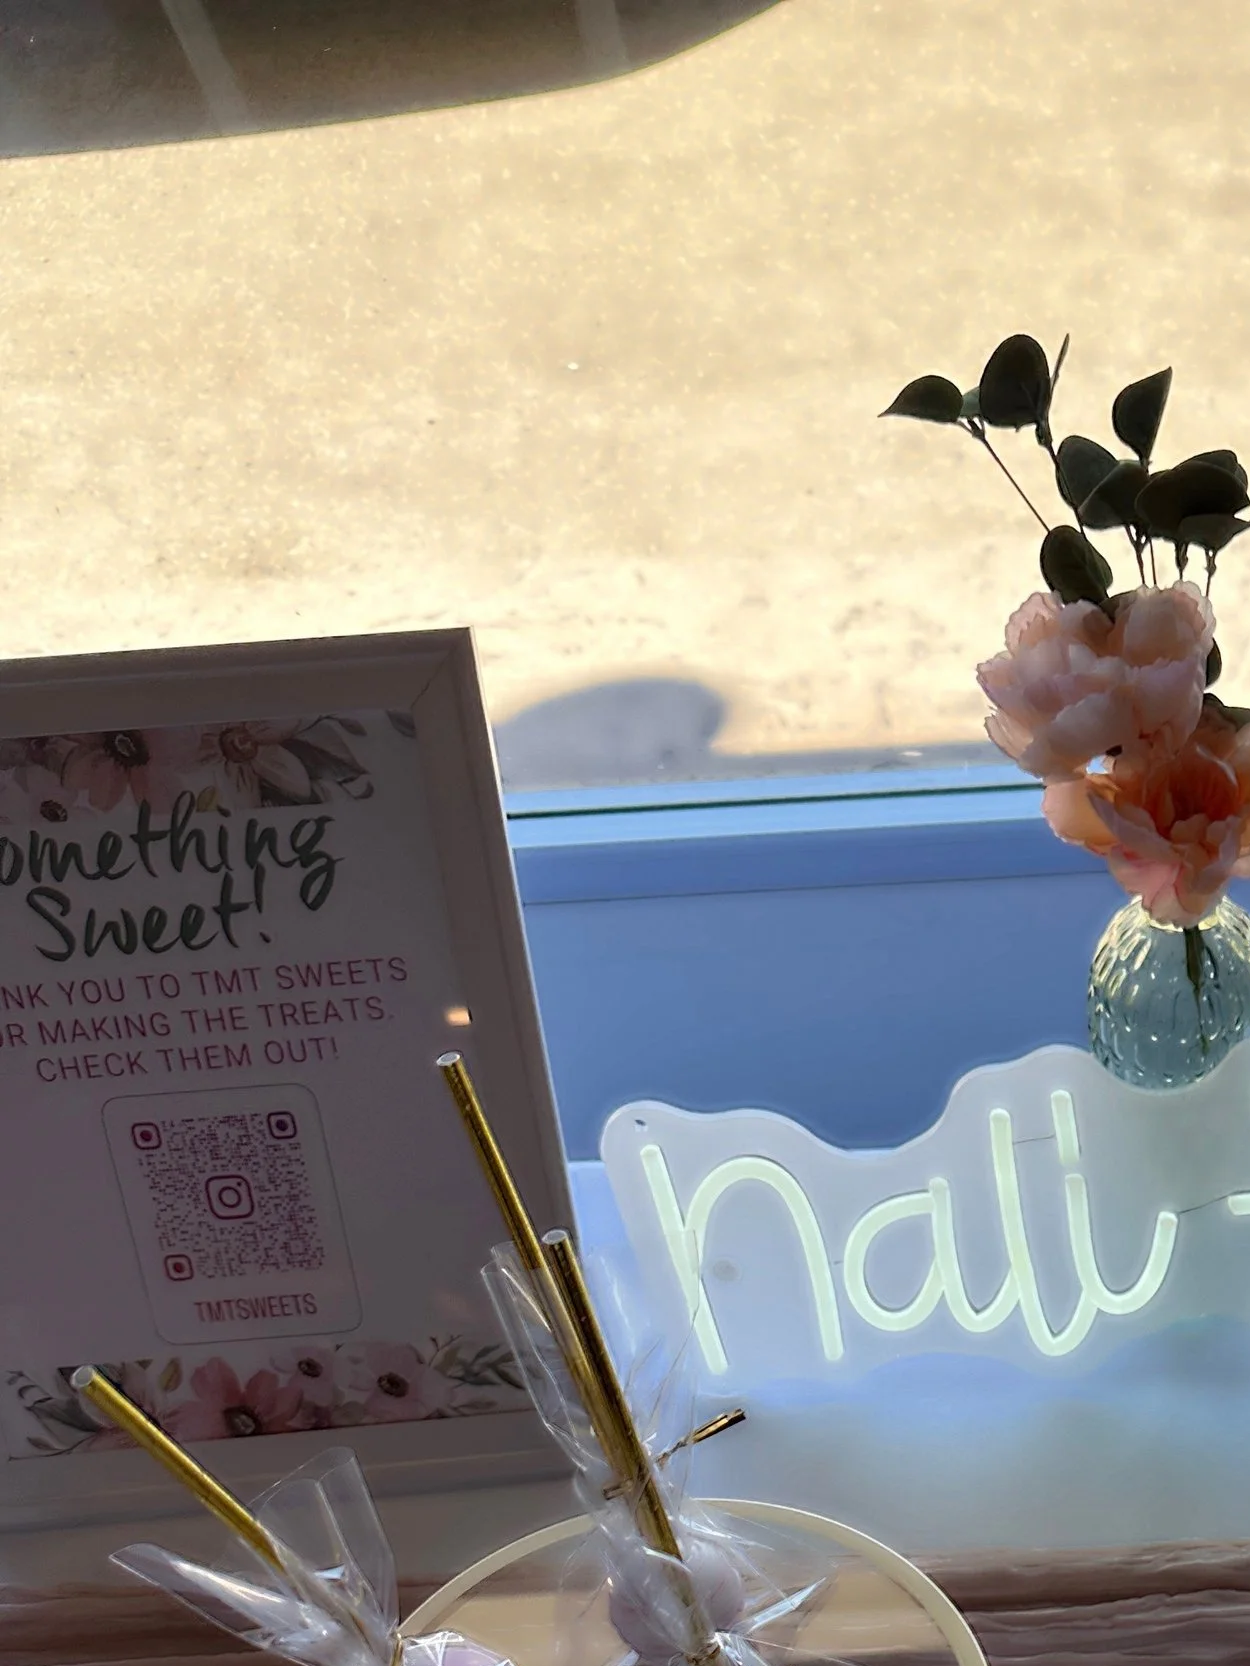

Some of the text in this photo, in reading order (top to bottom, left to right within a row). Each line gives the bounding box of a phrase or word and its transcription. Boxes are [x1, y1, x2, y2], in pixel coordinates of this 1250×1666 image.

[0, 790, 345, 911] omething
[26, 864, 272, 962] Sweet!
[0, 956, 408, 1010] NK YOU TO TMT SWEETS
[38, 1011, 171, 1046] MAKING
[181, 1006, 249, 1034] THE
[36, 1037, 340, 1082] CHECK THEM OUT!
[194, 1292, 318, 1323] TMTSWEETS
